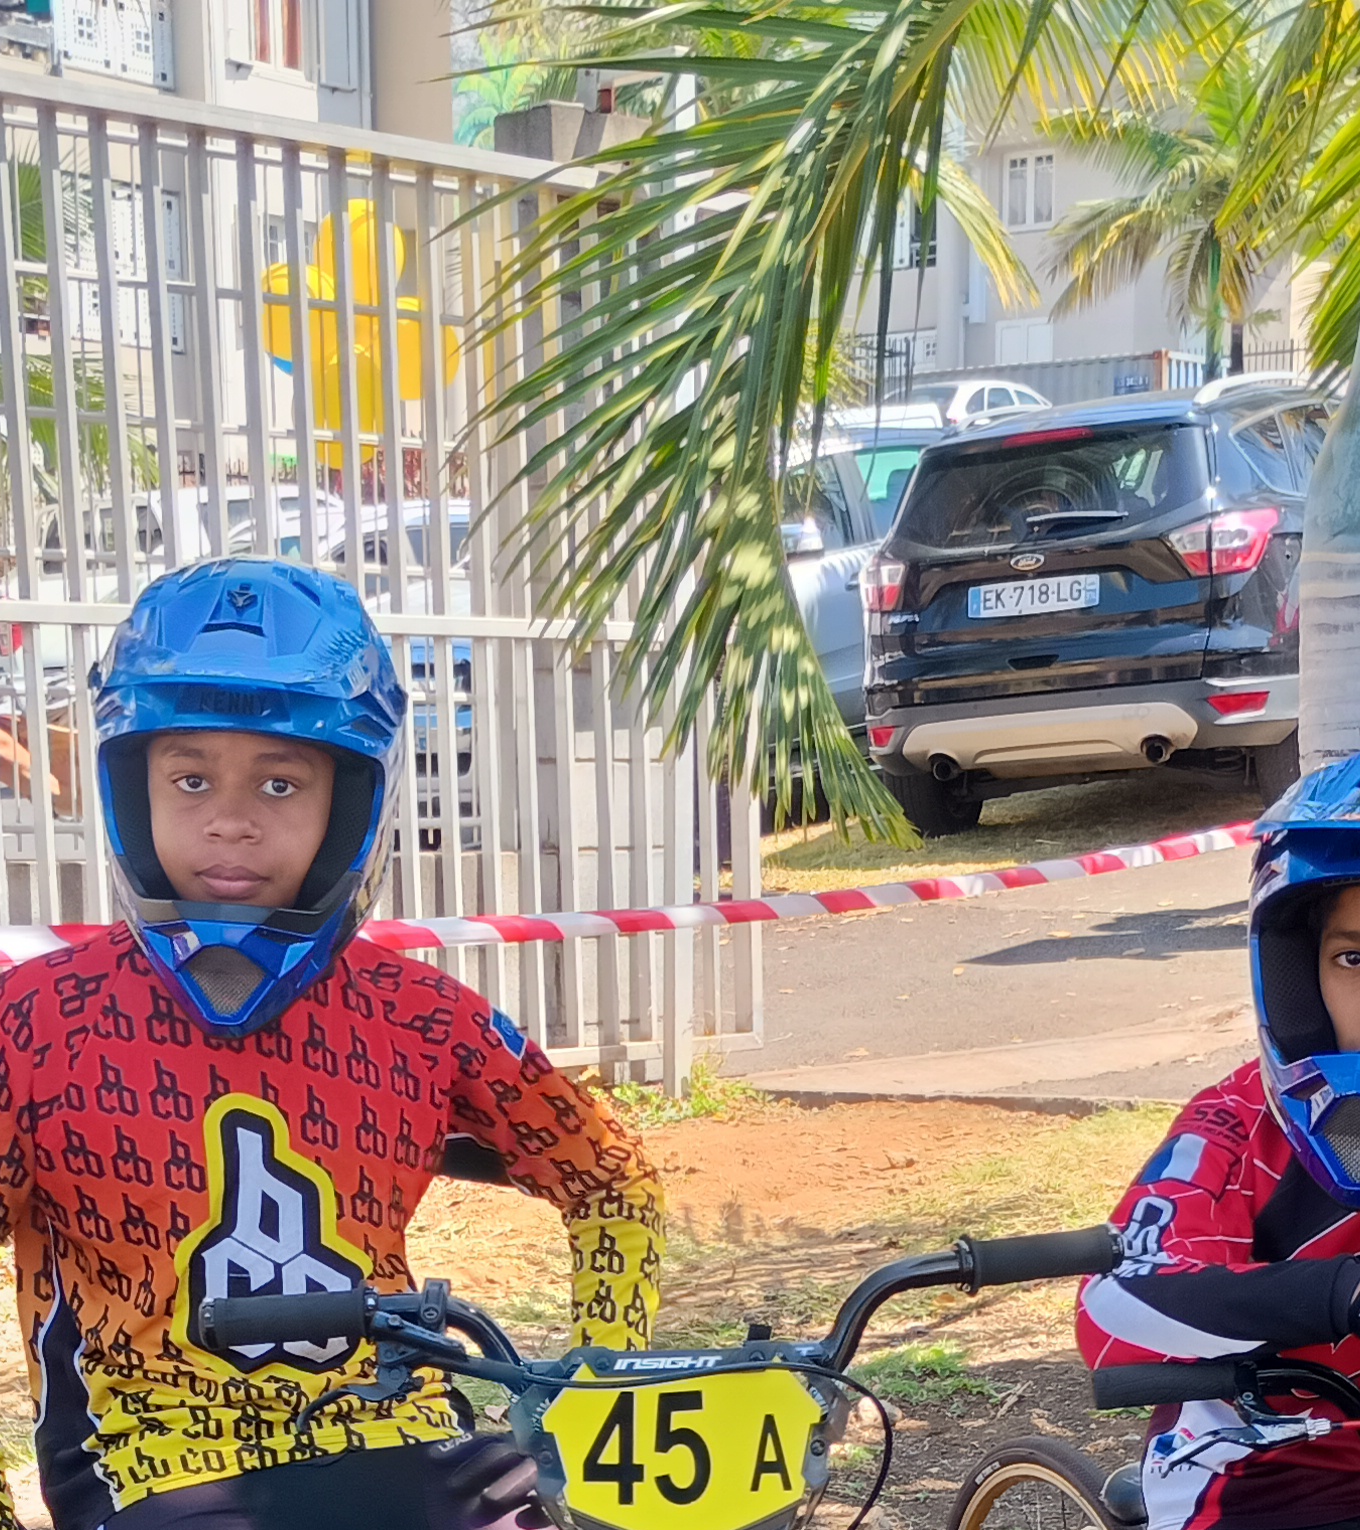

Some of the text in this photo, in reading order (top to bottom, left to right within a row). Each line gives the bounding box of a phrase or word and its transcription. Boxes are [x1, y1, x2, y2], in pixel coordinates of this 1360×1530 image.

[983, 580, 1082, 611] EK-718-LG
[613, 1354, 723, 1371] INSIGHT
[582, 1390, 793, 1505] 45 A
